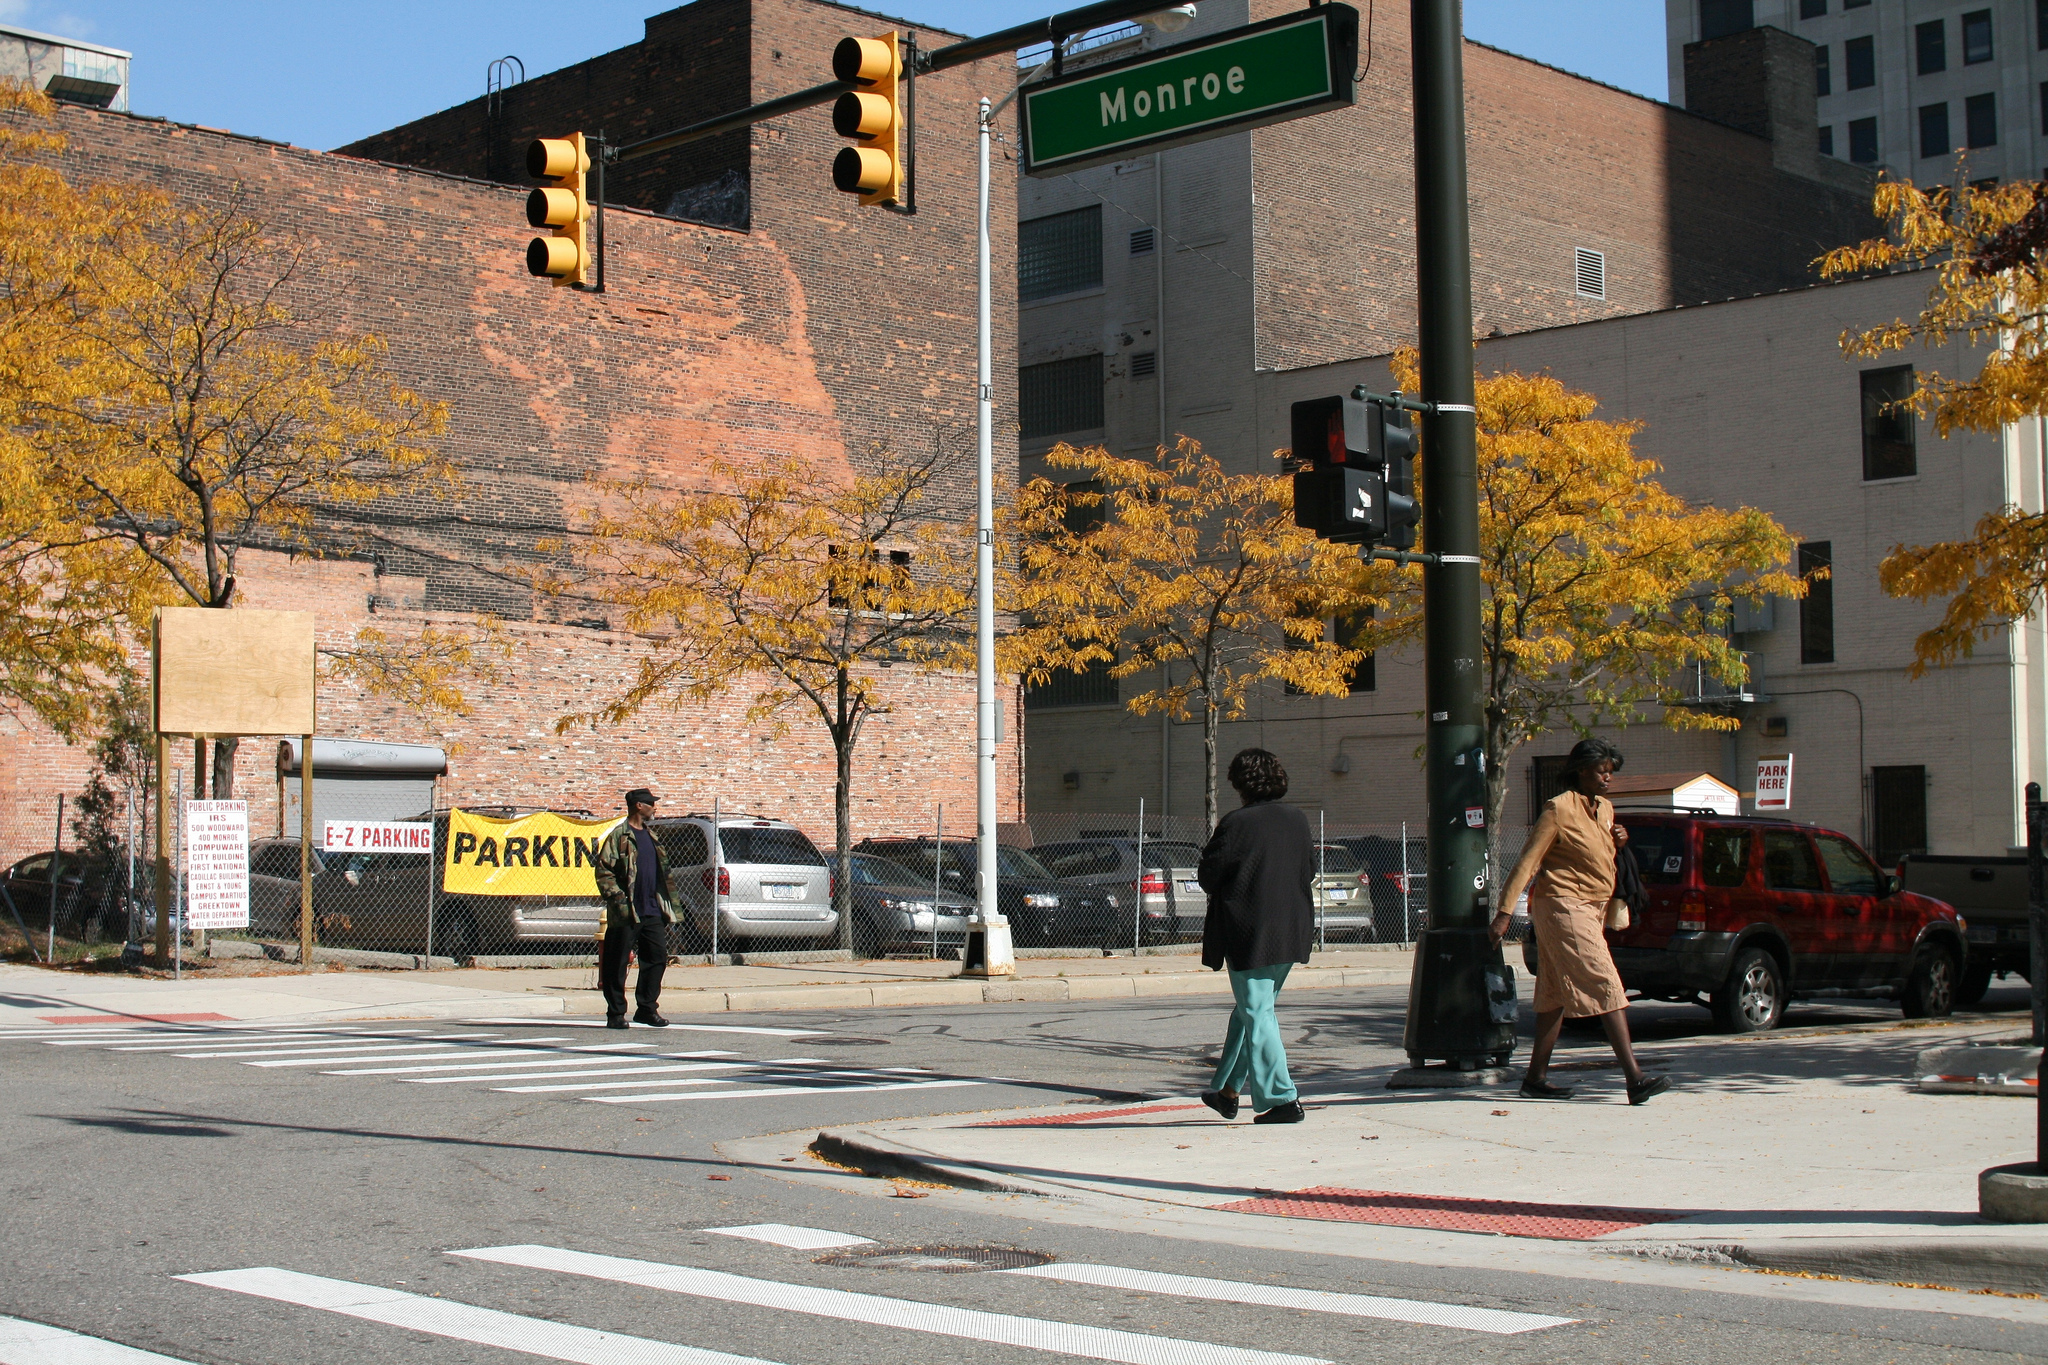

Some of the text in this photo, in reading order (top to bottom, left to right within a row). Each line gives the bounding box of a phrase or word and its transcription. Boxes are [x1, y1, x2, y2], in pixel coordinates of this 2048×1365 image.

[1100, 66, 1245, 127] Monroe
[1758, 766, 1788, 777] PARK
[1759, 779, 1784, 789] HERE
[189, 802, 246, 811] PUBLIC PARKING
[326, 827, 430, 848] E-Z PARKING
[453, 831, 599, 868] PARKIN
[212, 853, 245, 861] BUILDING
[191, 863, 210, 871] FIRST
[191, 872, 247, 881] CADILLAC BUILDINGS
[217, 882, 221, 890] &
[224, 882, 242, 890] YOUNG
[198, 902, 240, 910] GREEKTOWN
[212, 911, 247, 919] DEPARTMENT
